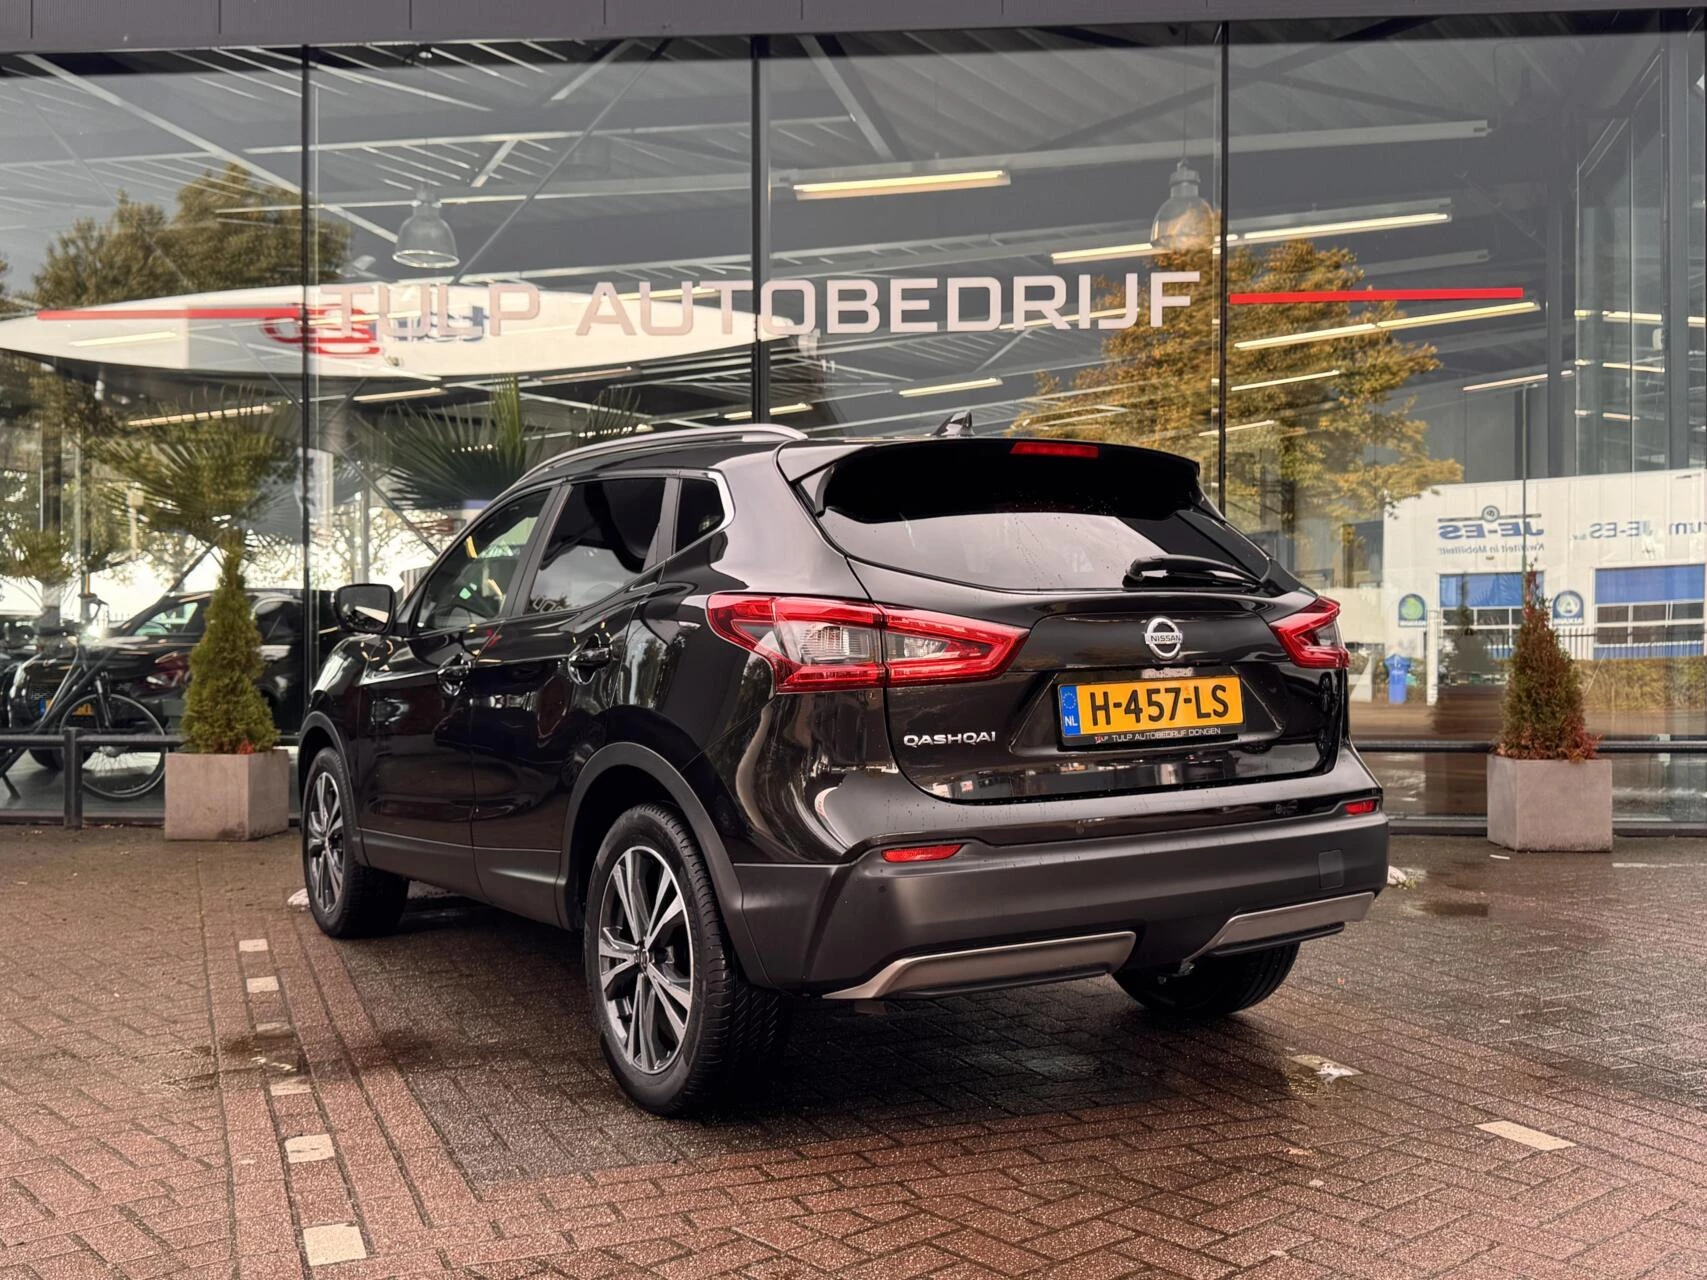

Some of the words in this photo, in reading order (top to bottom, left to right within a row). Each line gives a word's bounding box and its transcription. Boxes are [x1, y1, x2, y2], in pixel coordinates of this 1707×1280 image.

[320, 282, 541, 337] TULP
[575, 271, 1200, 336] AUTOBEDRIJF
[1150, 634, 1181, 642] NISSAN
[1089, 684, 1229, 726] H-457-LS
[1064, 716, 1078, 727] NL
[903, 731, 996, 748] QASHQAI
[1112, 734, 1132, 742] TULP
[1134, 729, 1187, 741] AUTOBEDRIJF
[1188, 727, 1221, 737] DONGEN
